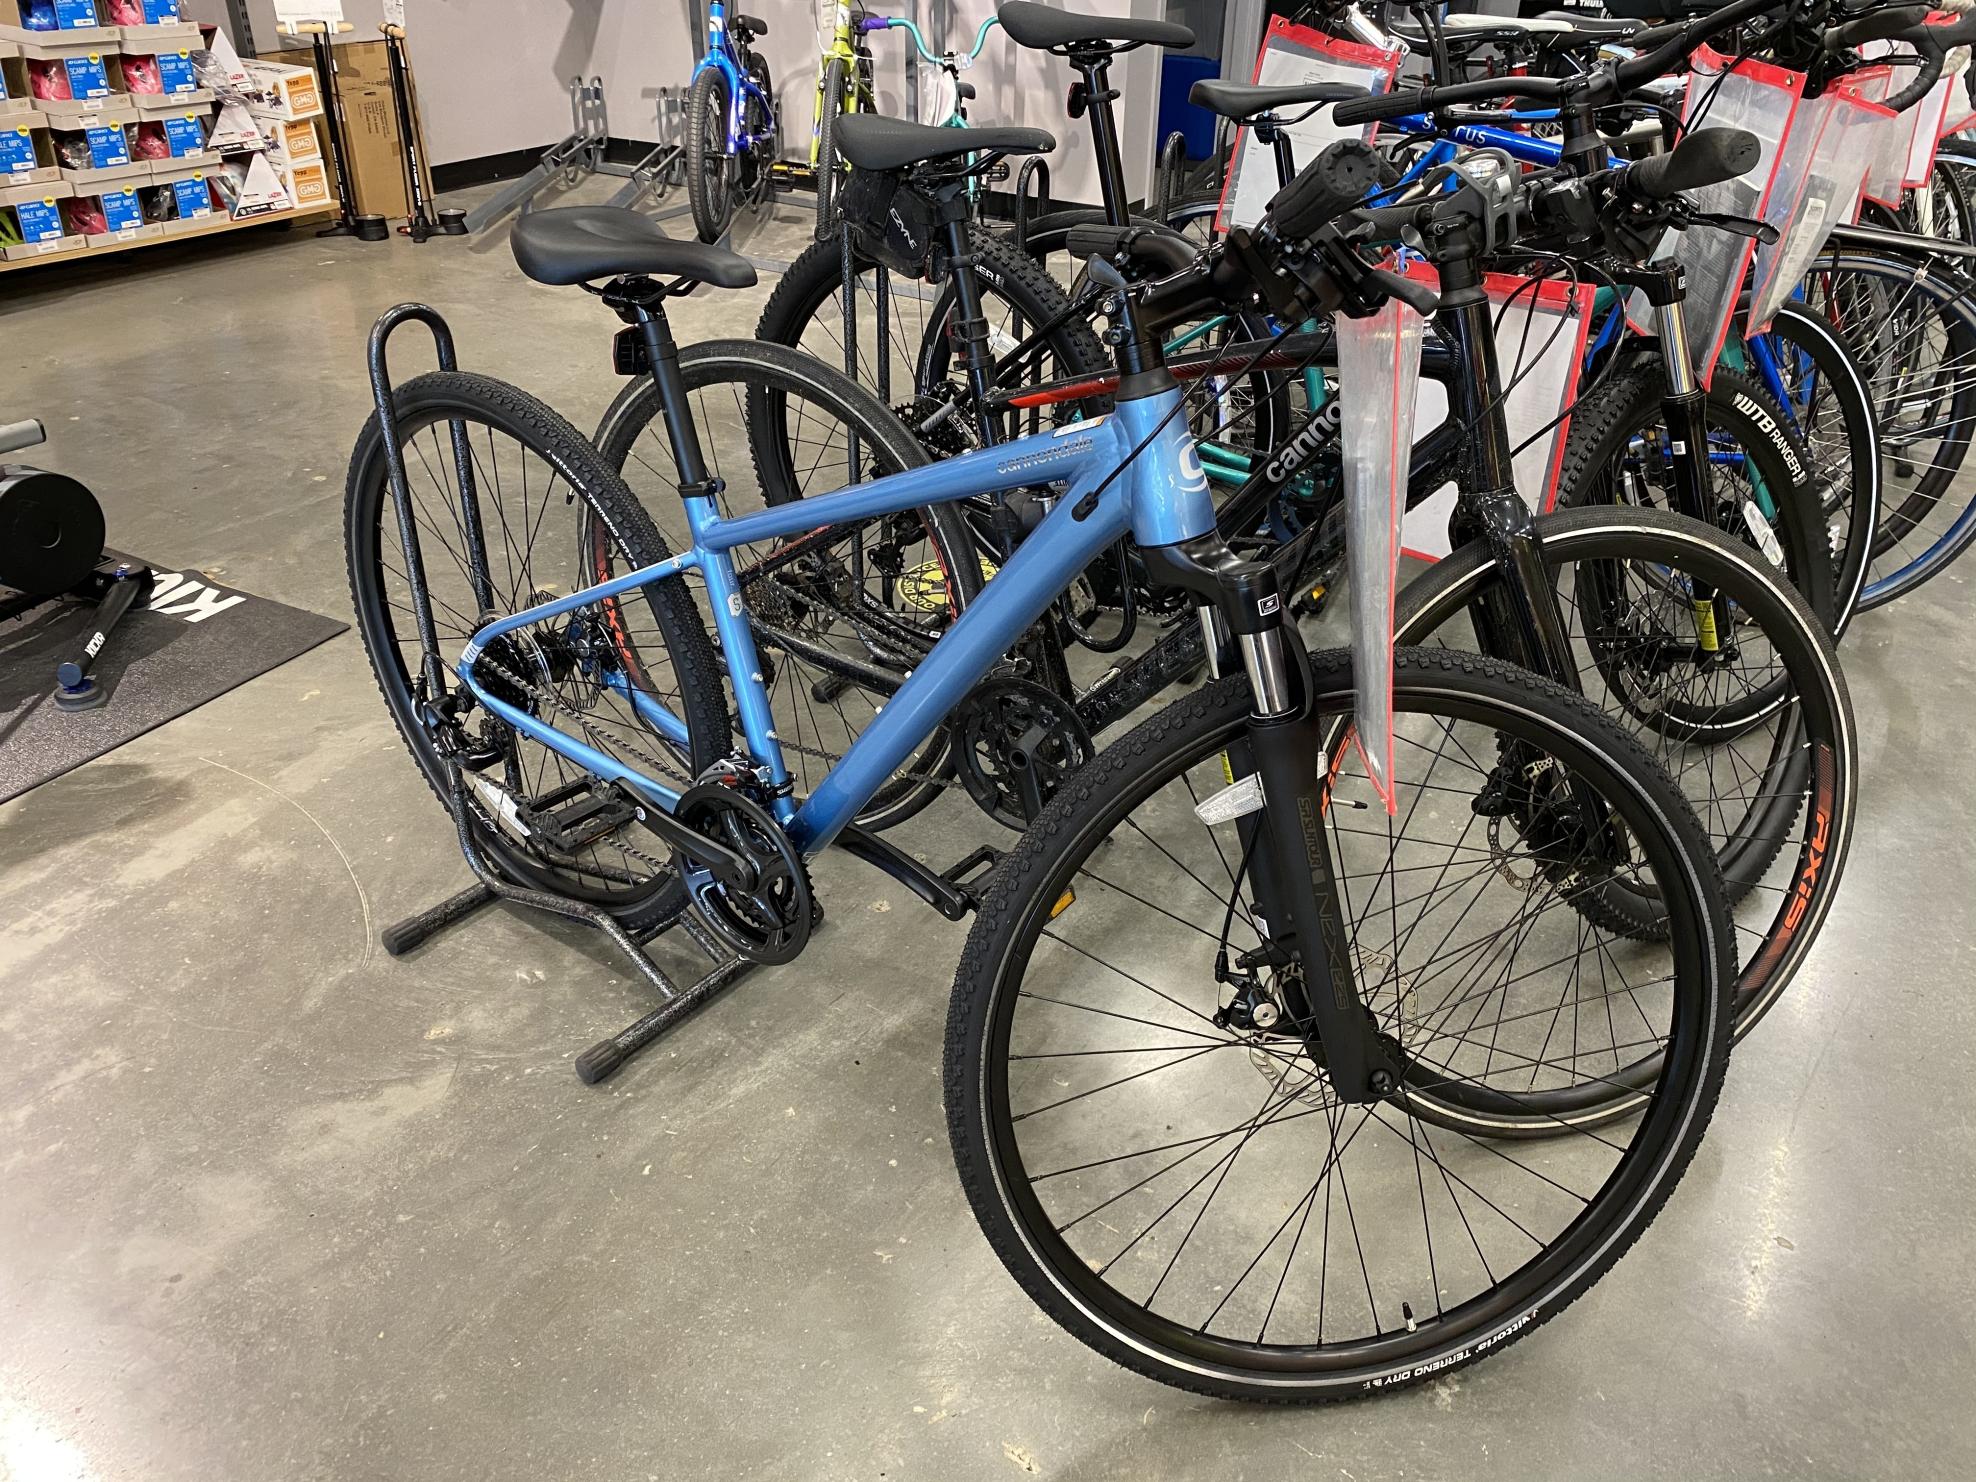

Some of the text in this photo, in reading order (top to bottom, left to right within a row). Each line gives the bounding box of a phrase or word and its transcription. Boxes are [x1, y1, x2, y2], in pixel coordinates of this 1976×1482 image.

[890, 207, 917, 249] EZYNE
[997, 434, 1093, 474] cannondale
[1266, 400, 1341, 483] canno
[1737, 395, 1803, 477] WTB RANGER
[587, 492, 619, 537] TERRENO
[618, 538, 634, 560] DRY
[1384, 1371, 1411, 1386] DRY
[1414, 1350, 1471, 1377] TERRENO
